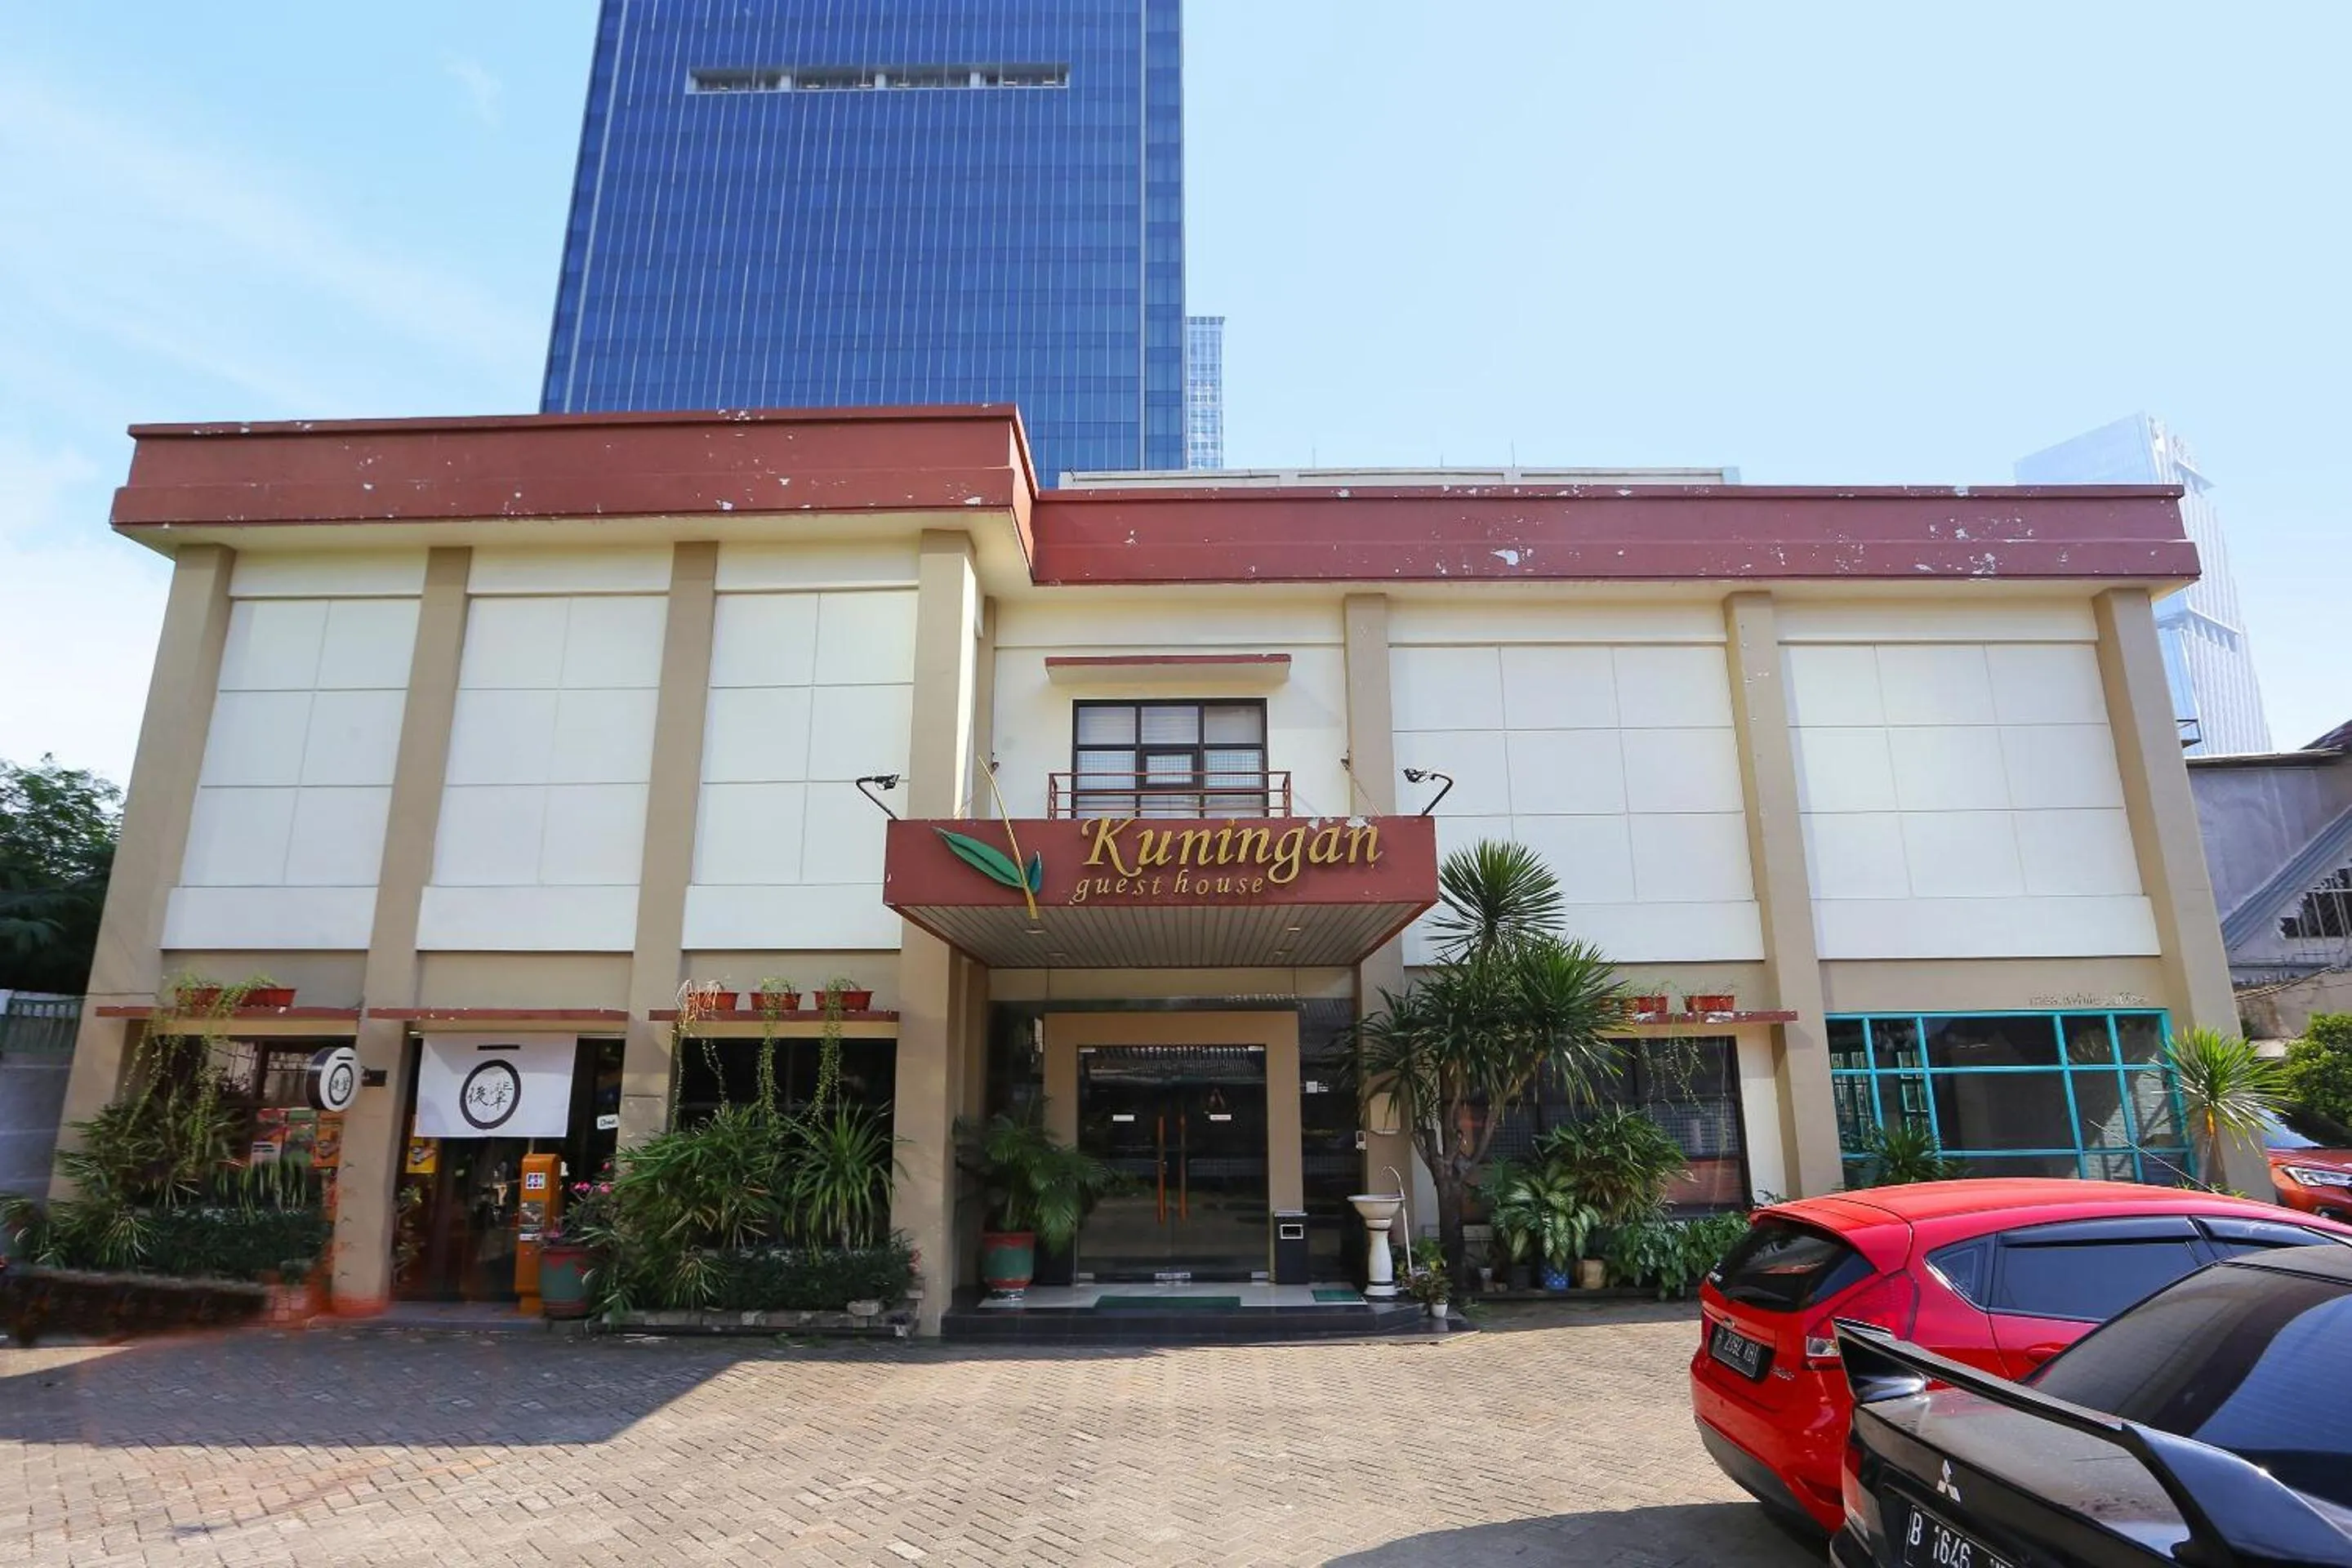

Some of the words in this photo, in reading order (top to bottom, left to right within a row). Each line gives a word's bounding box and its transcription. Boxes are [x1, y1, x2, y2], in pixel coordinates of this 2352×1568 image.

[1081, 817, 1383, 884] Kuningan
[1072, 875, 1161, 902] guest
[1174, 869, 1264, 894] house
[1909, 1512, 1923, 1545] B
[1932, 1525, 1971, 1568] 1646
